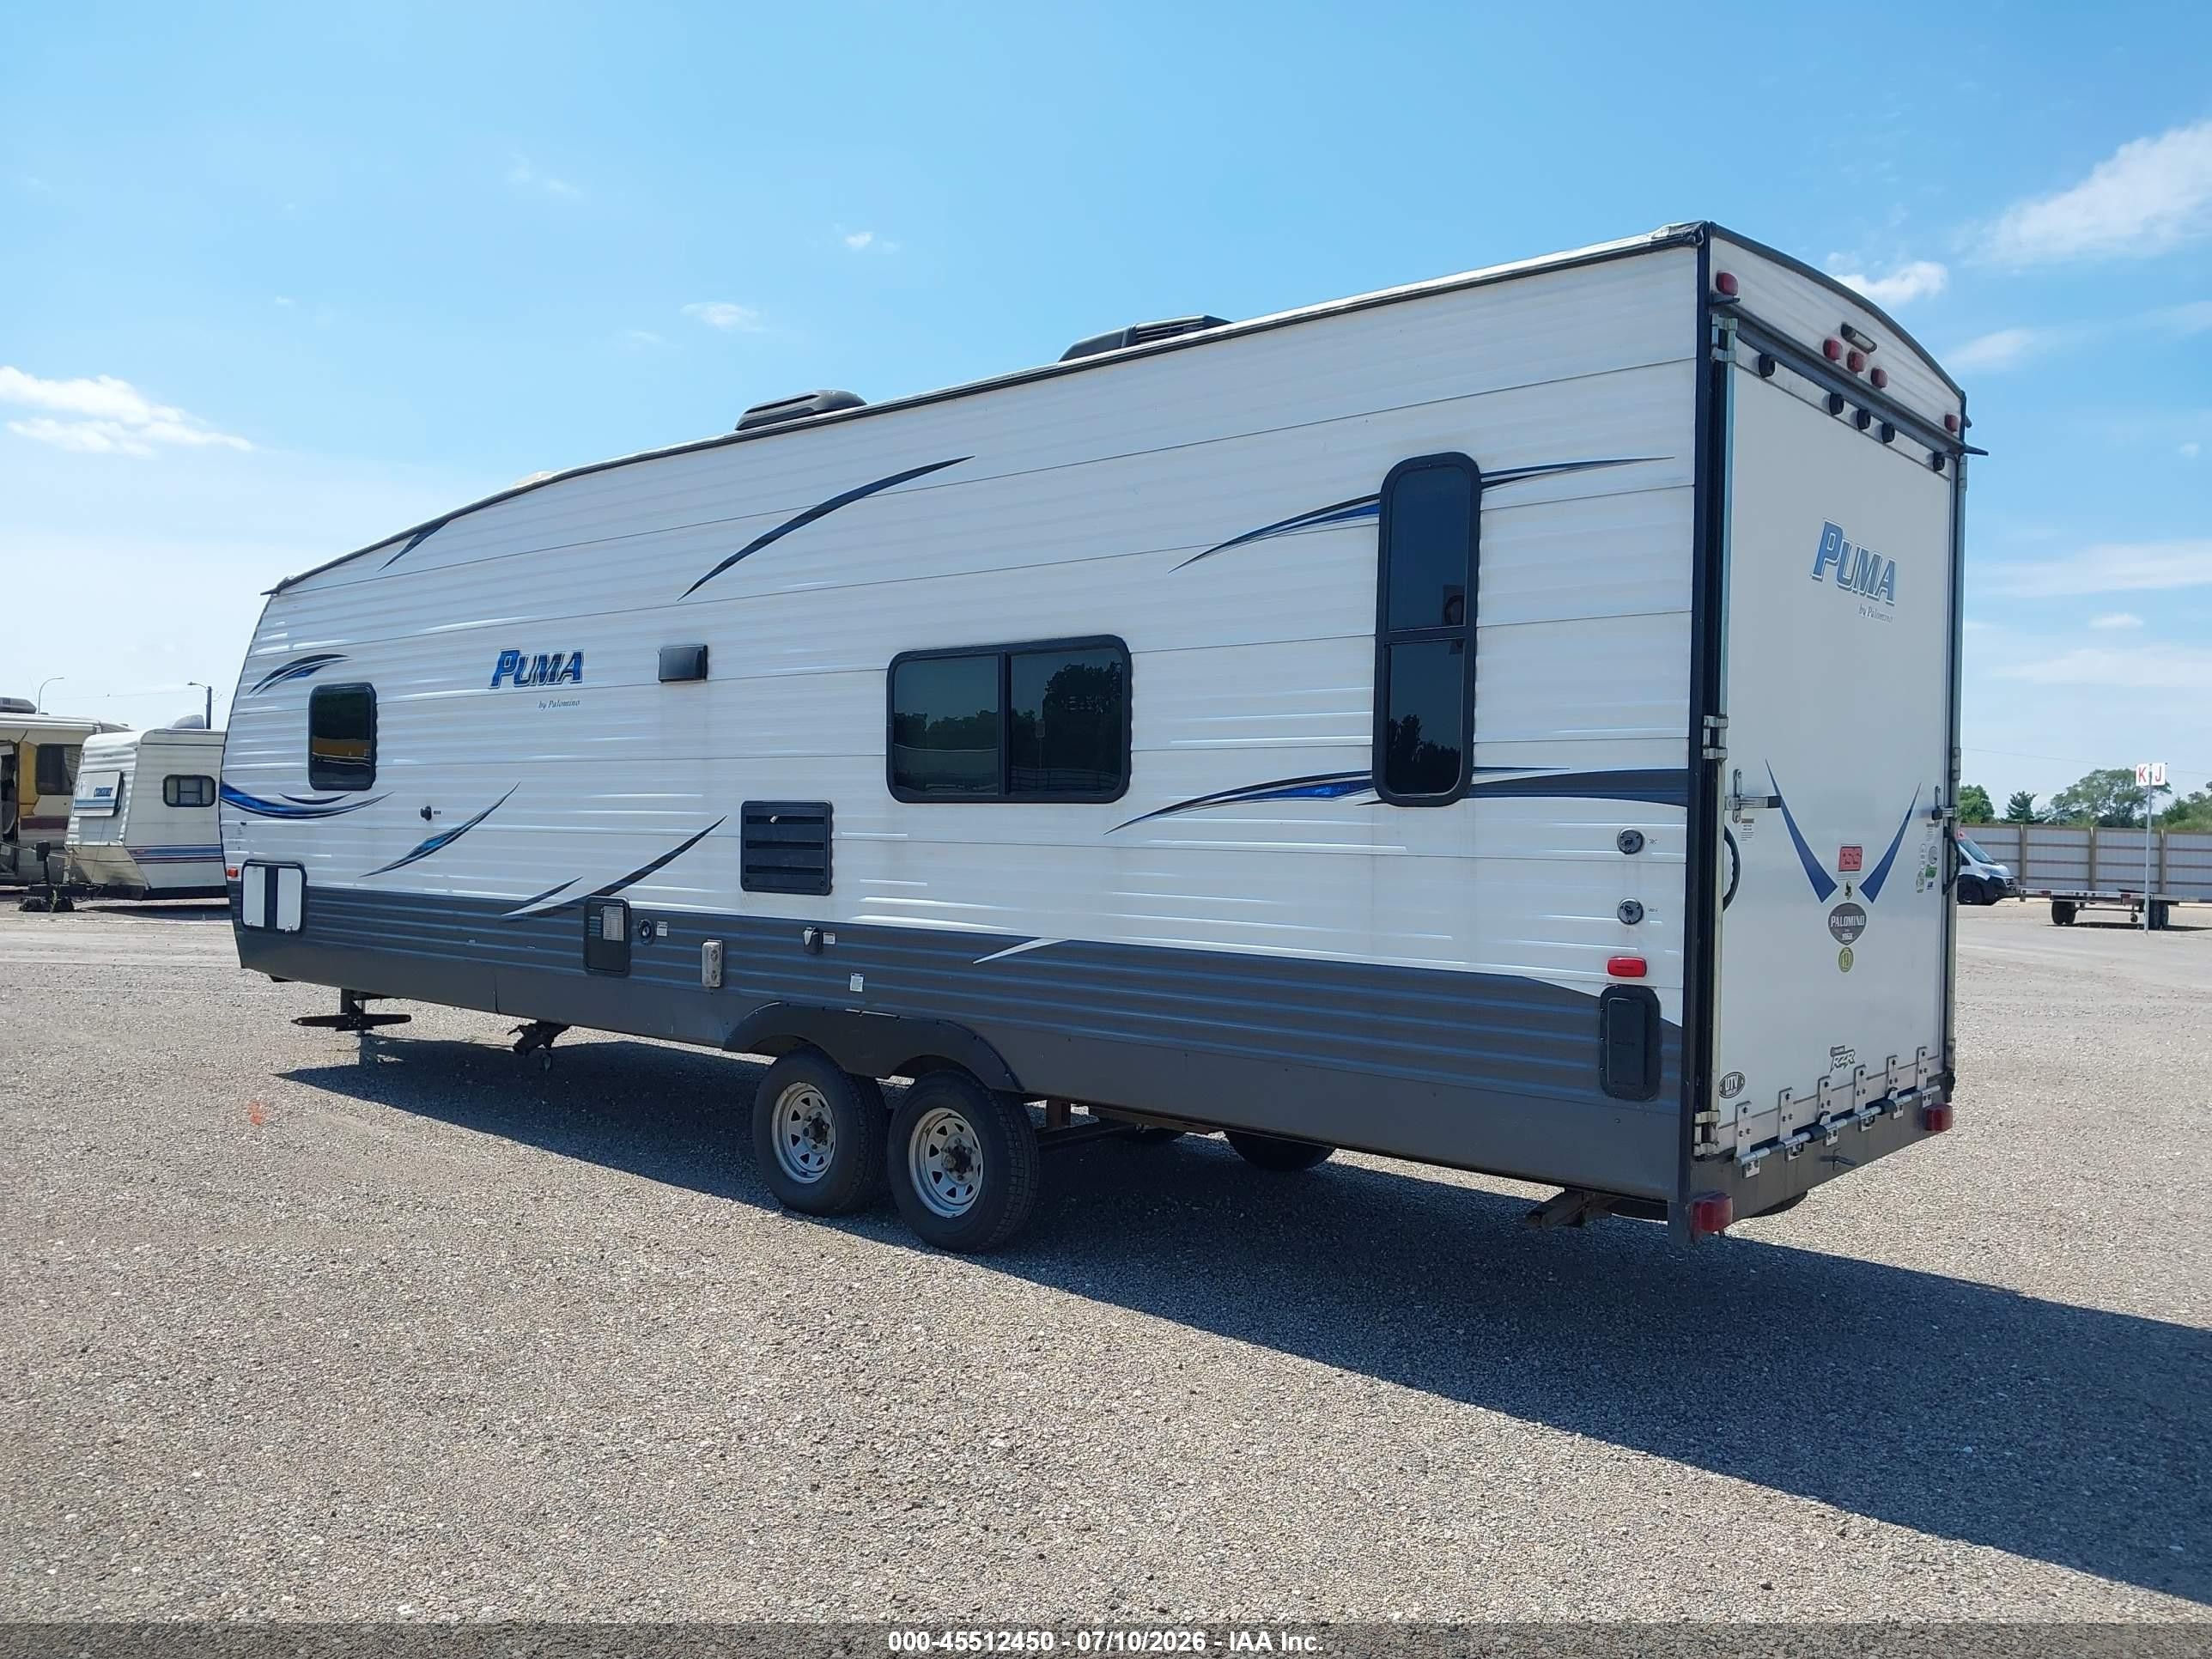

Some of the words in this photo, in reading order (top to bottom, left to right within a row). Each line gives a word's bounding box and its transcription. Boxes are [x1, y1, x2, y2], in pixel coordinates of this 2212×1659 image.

[1810, 517, 1896, 606] PUMA
[489, 648, 584, 689] PUMA
[2138, 767, 2147, 783] K
[2155, 765, 2162, 782] J
[1831, 915, 1865, 927] PALOMINO
[1832, 1050, 1855, 1069] RZR
[1724, 1074, 1739, 1091] UTV
